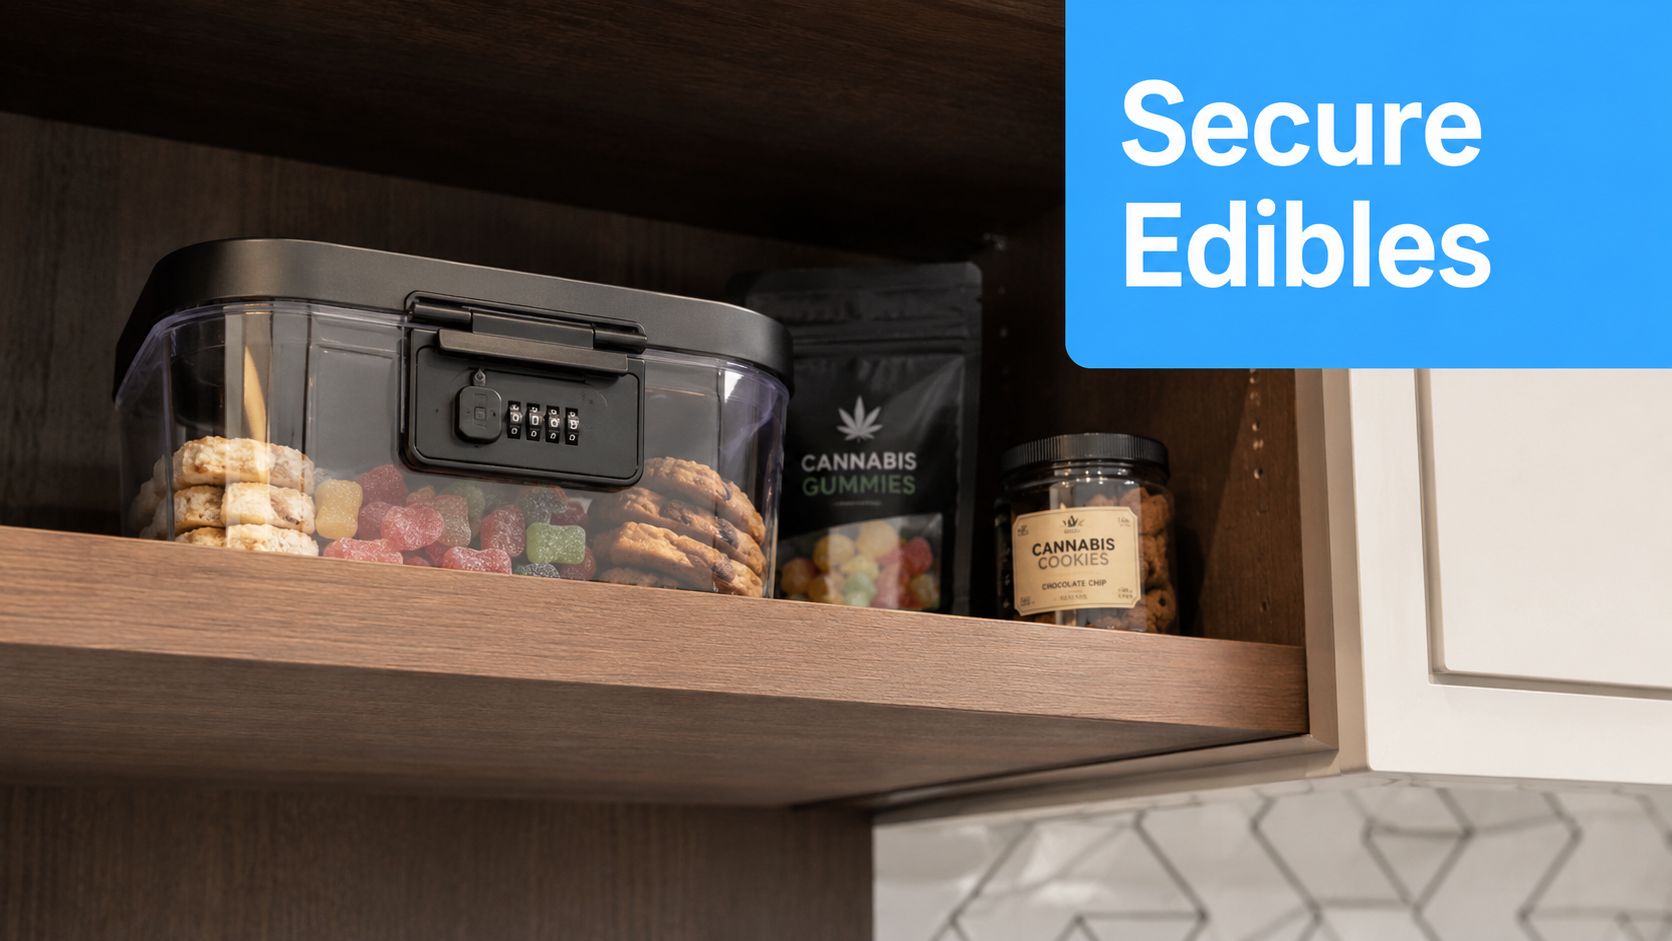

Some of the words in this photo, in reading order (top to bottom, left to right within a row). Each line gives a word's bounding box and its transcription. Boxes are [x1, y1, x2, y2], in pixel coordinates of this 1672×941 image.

[801, 451, 917, 472] CANNABIS
[802, 474, 917, 497] GUMMIES
[1032, 537, 1116, 557] CANNABIS
[1038, 552, 1110, 570] COOKIES
[1041, 580, 1086, 590] CHOCOLATE
[1088, 579, 1108, 587] CHIP
